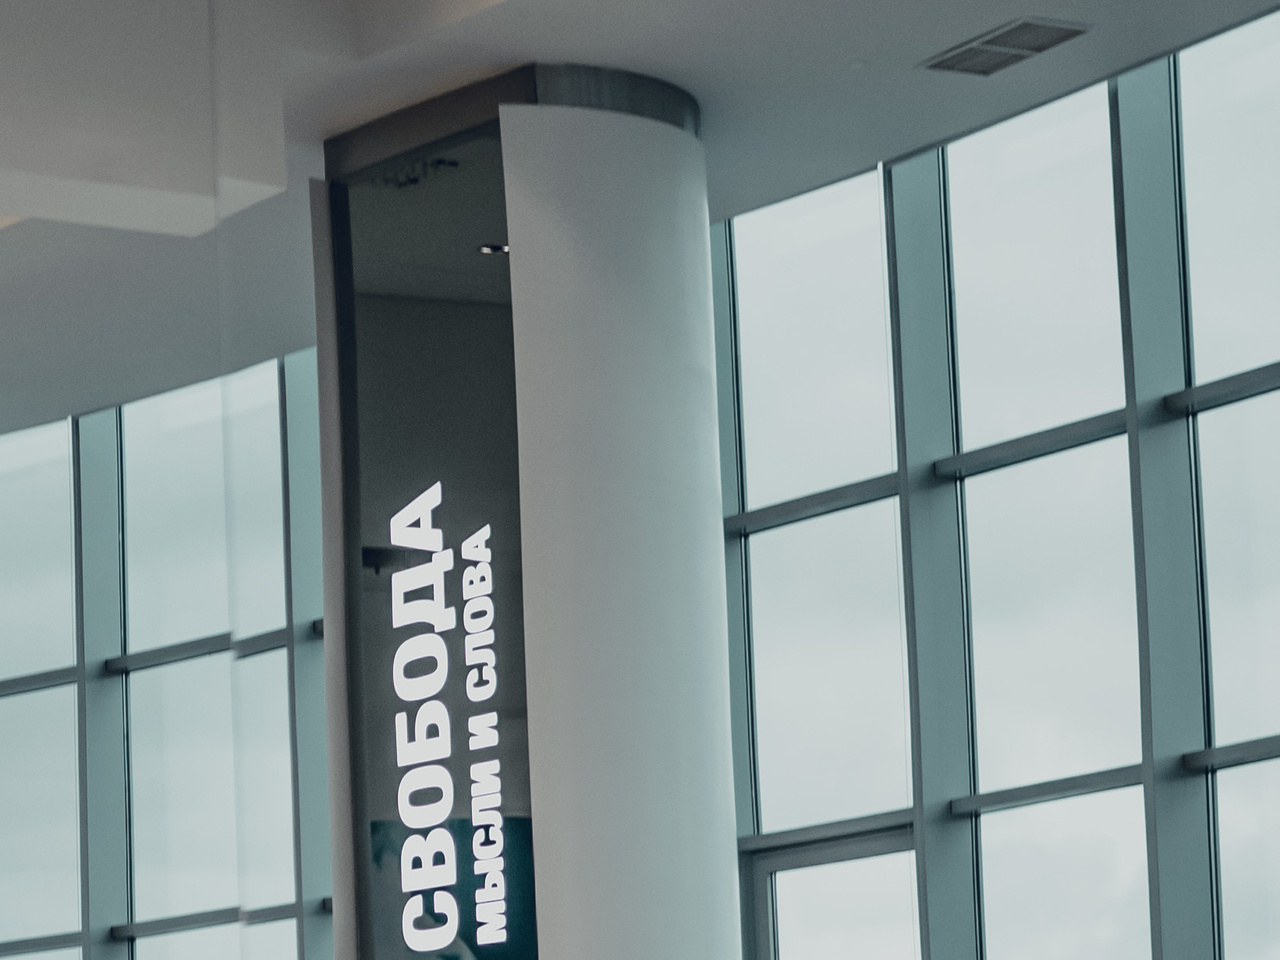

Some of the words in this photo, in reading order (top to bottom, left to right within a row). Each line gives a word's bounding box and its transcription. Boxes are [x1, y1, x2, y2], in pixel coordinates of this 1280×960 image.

[461, 523, 498, 703] СЛОВА
[389, 480, 460, 953] СВОБОДА
[467, 711, 499, 752] И
[469, 758, 508, 946] МЫСЛИ
